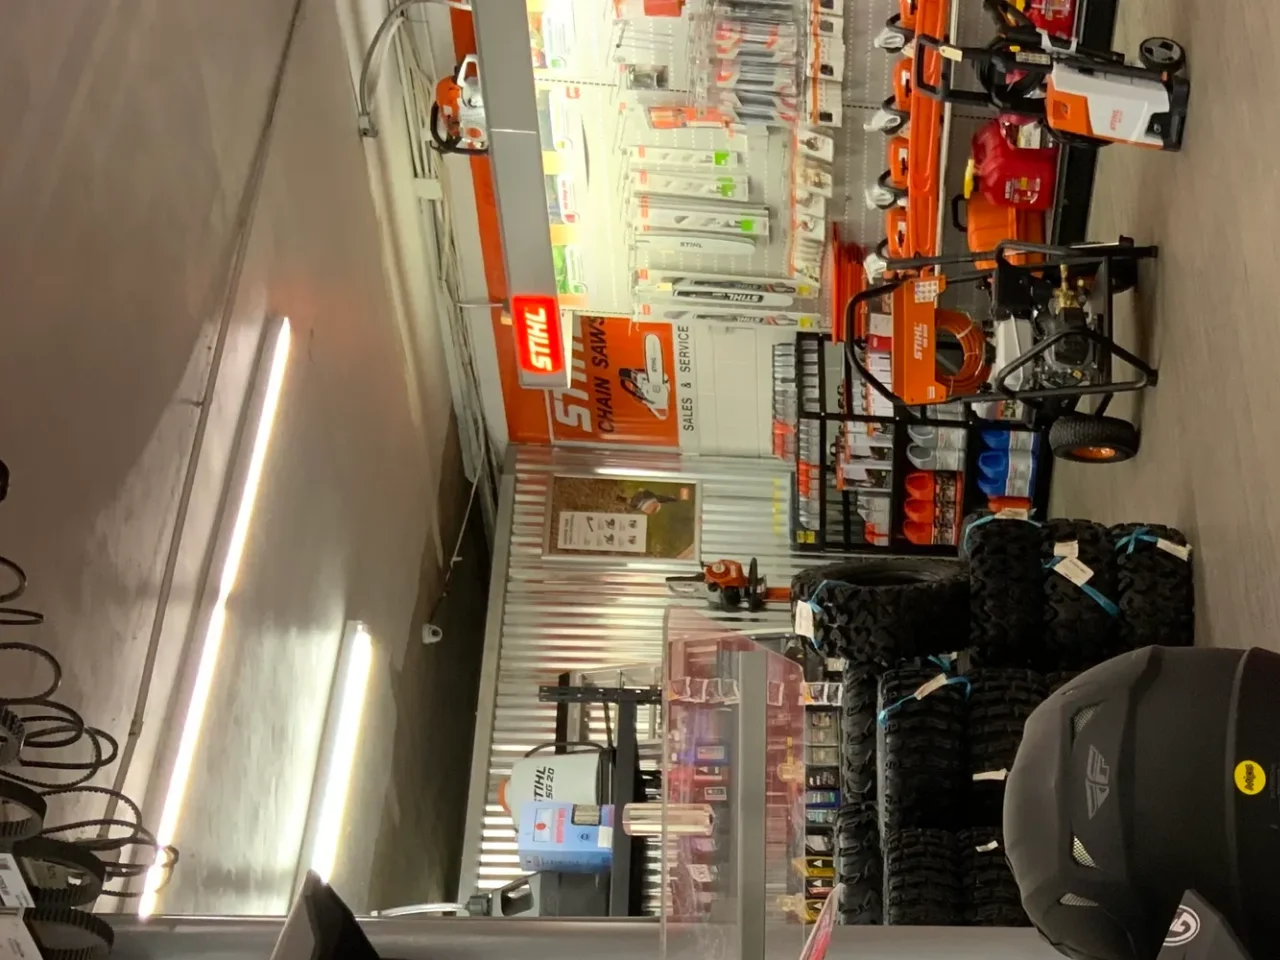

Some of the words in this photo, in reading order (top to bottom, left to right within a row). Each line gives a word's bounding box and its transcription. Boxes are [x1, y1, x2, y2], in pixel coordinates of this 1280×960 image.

[727, 293, 760, 303] STIHL
[524, 307, 552, 371] STIHL
[677, 325, 691, 373] SERVICE
[914, 322, 922, 360] STIHL
[593, 376, 614, 433] CHAIN
[682, 397, 694, 431] SALES
[533, 766, 546, 802] TIHL
[546, 784, 554, 799] SG
[547, 768, 555, 783] 20
